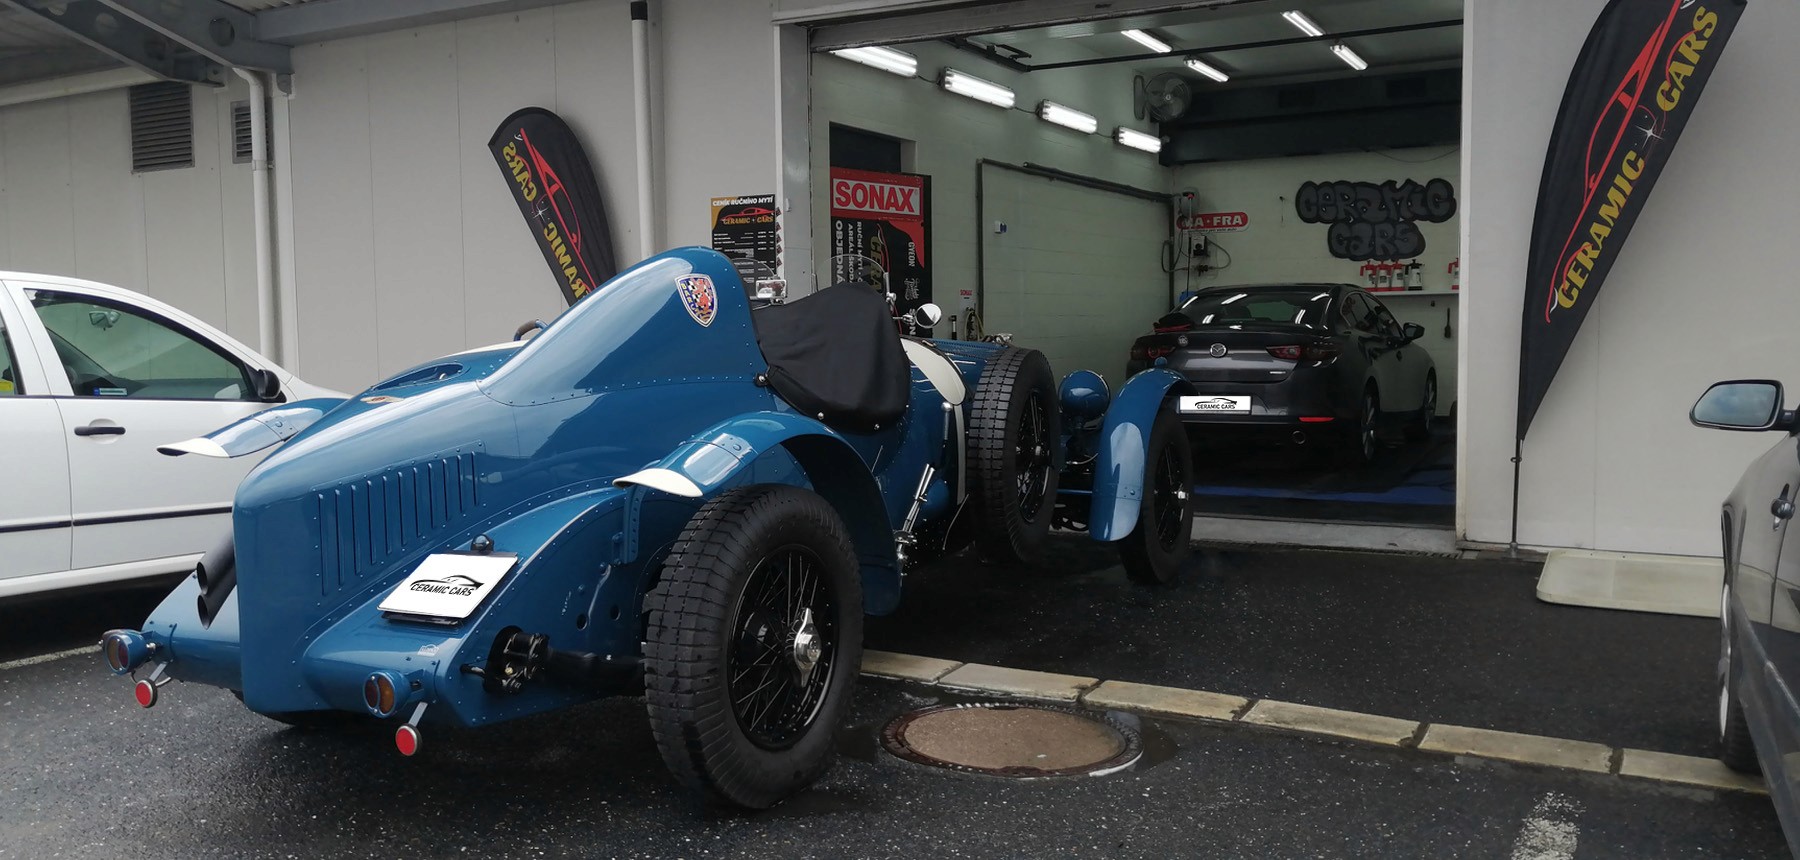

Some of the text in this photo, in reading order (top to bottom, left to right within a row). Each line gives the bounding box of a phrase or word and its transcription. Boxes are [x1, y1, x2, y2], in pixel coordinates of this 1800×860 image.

[1557, 6, 1718, 309] CERAMIC CARS
[835, 181, 915, 213] SONAX
[835, 220, 846, 284] OBJEDNÁ
[847, 255, 855, 283] ŠKOD
[870, 236, 882, 291] CERA
[410, 583, 475, 597] CERAMIC CARS
